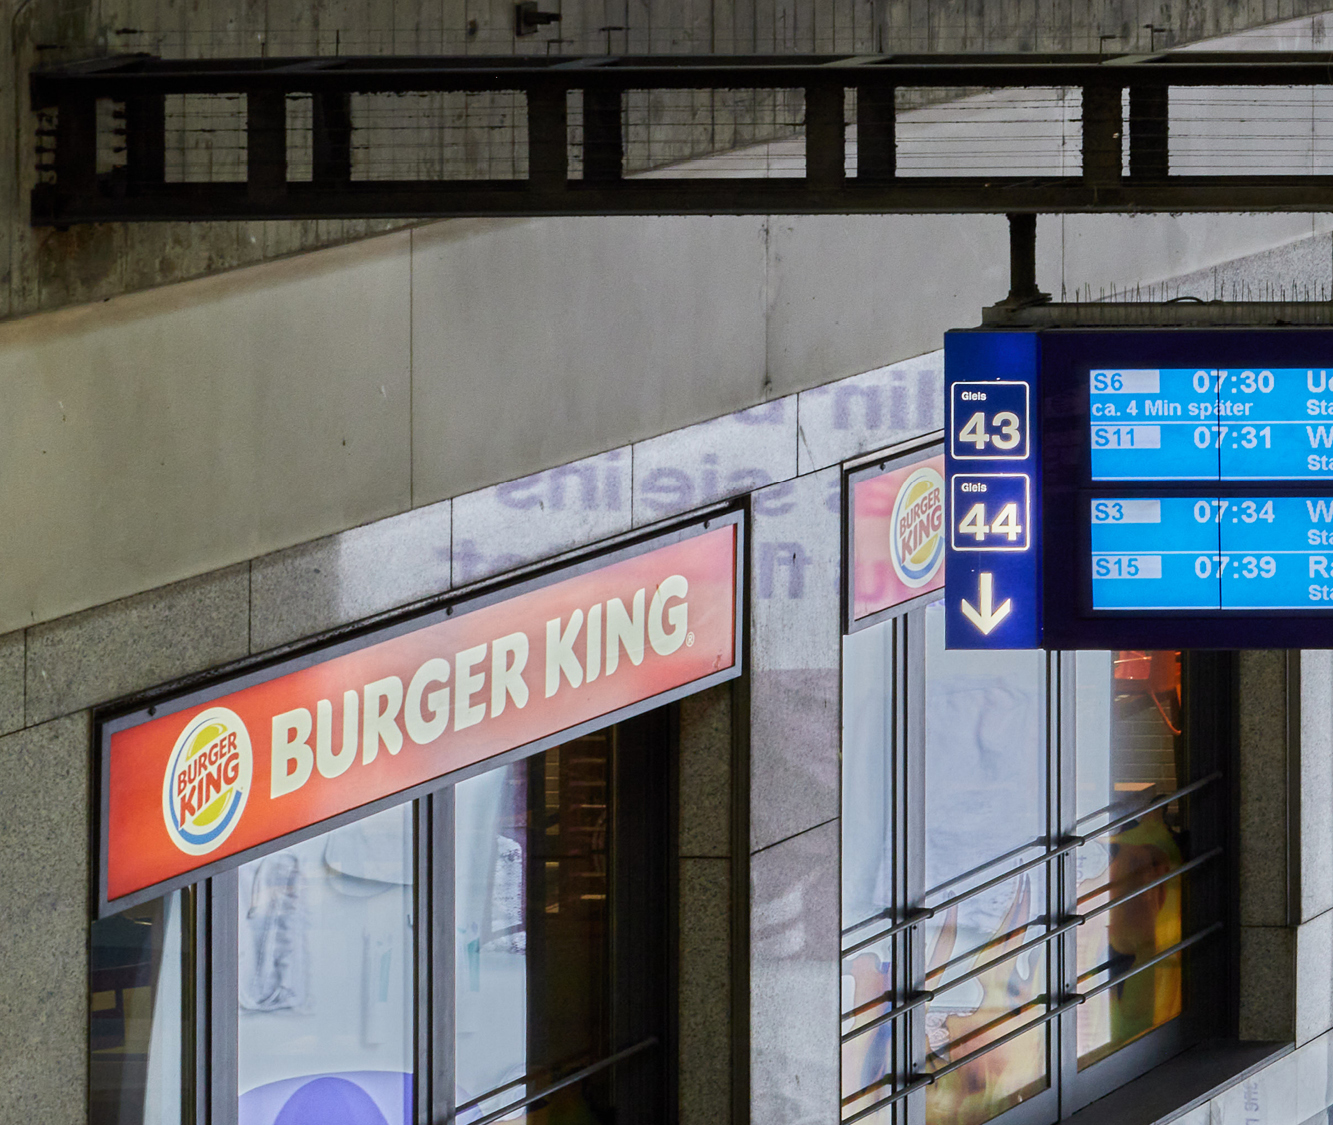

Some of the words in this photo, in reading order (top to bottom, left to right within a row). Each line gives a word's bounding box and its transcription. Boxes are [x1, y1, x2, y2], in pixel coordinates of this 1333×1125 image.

[961, 391, 987, 401] Gleis
[1093, 372, 1123, 391] S6
[1193, 371, 1274, 393] 07:30
[1092, 403, 1121, 416] ca.
[1126, 400, 1138, 415] 4
[1144, 400, 1182, 416] Min
[1188, 400, 1254, 419] später
[959, 412, 1021, 449] 43
[1094, 428, 1135, 447] S11
[1194, 426, 1271, 449] 07:31
[961, 483, 988, 493] Gleis
[900, 487, 941, 537] BURGER
[959, 503, 1022, 541] 44
[1094, 502, 1124, 522] S3
[1194, 501, 1275, 523] 07:34
[901, 505, 943, 564] KING
[1095, 557, 1140, 577] S15
[1195, 556, 1276, 578] 07:39
[270, 632, 529, 799] BURGER
[177, 731, 237, 797] BURGER
[180, 752, 240, 828] KING
